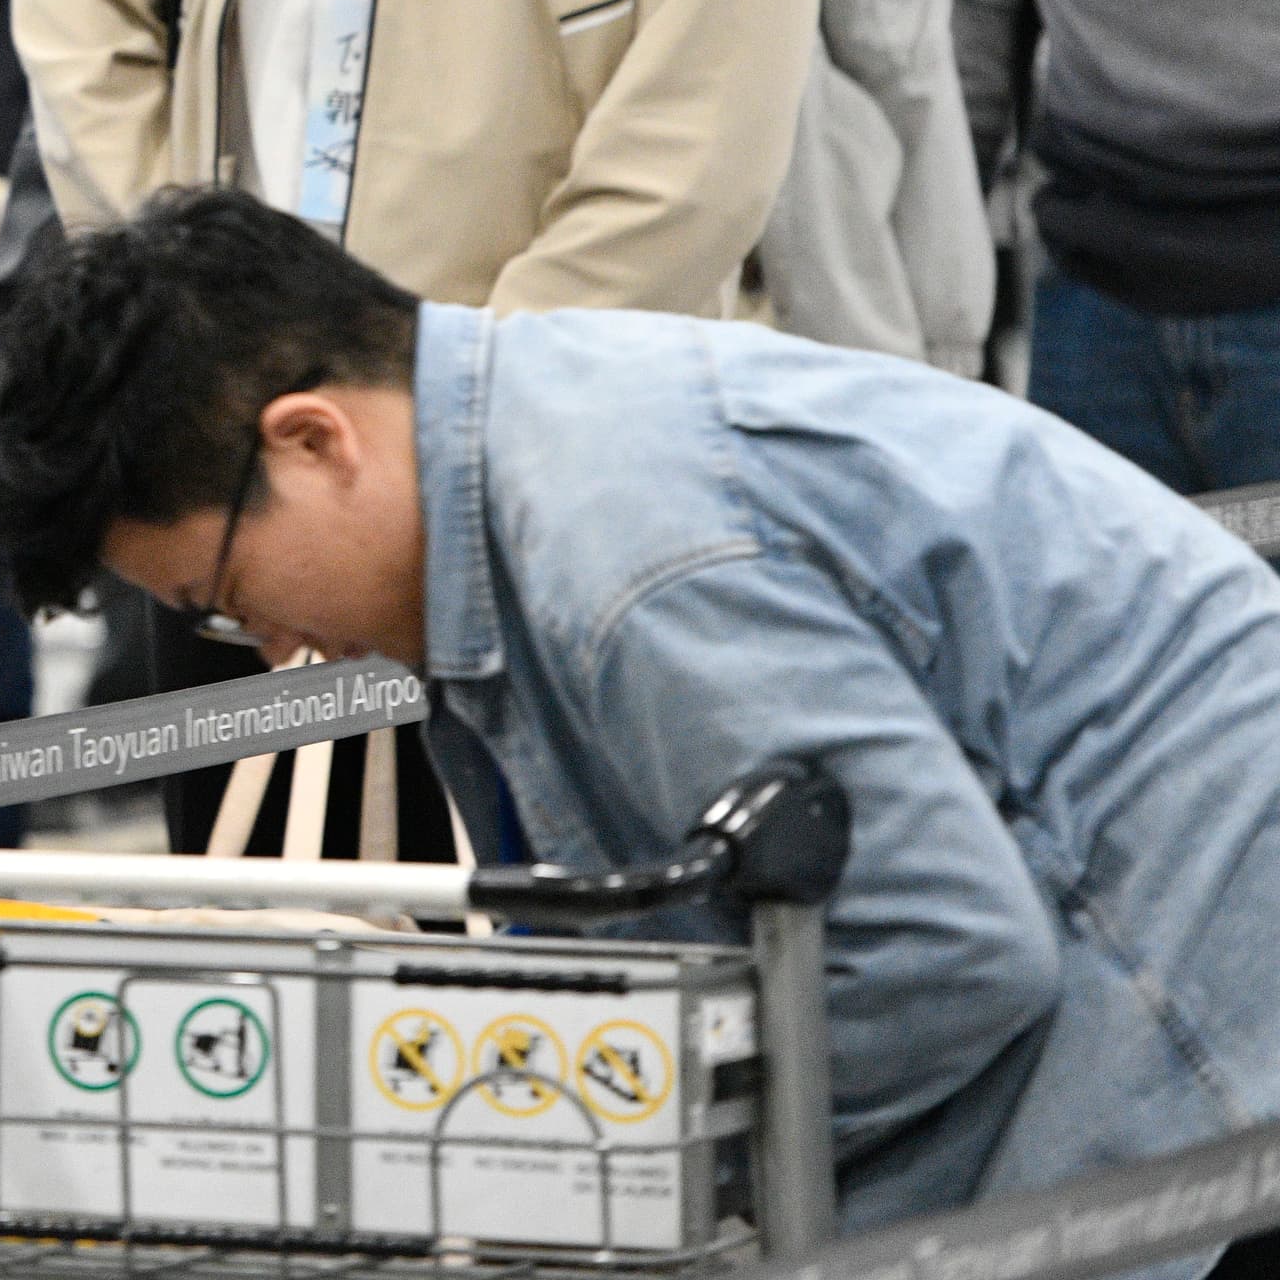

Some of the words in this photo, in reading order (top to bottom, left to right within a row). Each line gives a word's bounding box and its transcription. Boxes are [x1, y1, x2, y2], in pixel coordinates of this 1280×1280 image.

[67, 726, 179, 776] Taoyuan
[185, 675, 345, 749] International
[348, 672, 422, 721] Airpo
